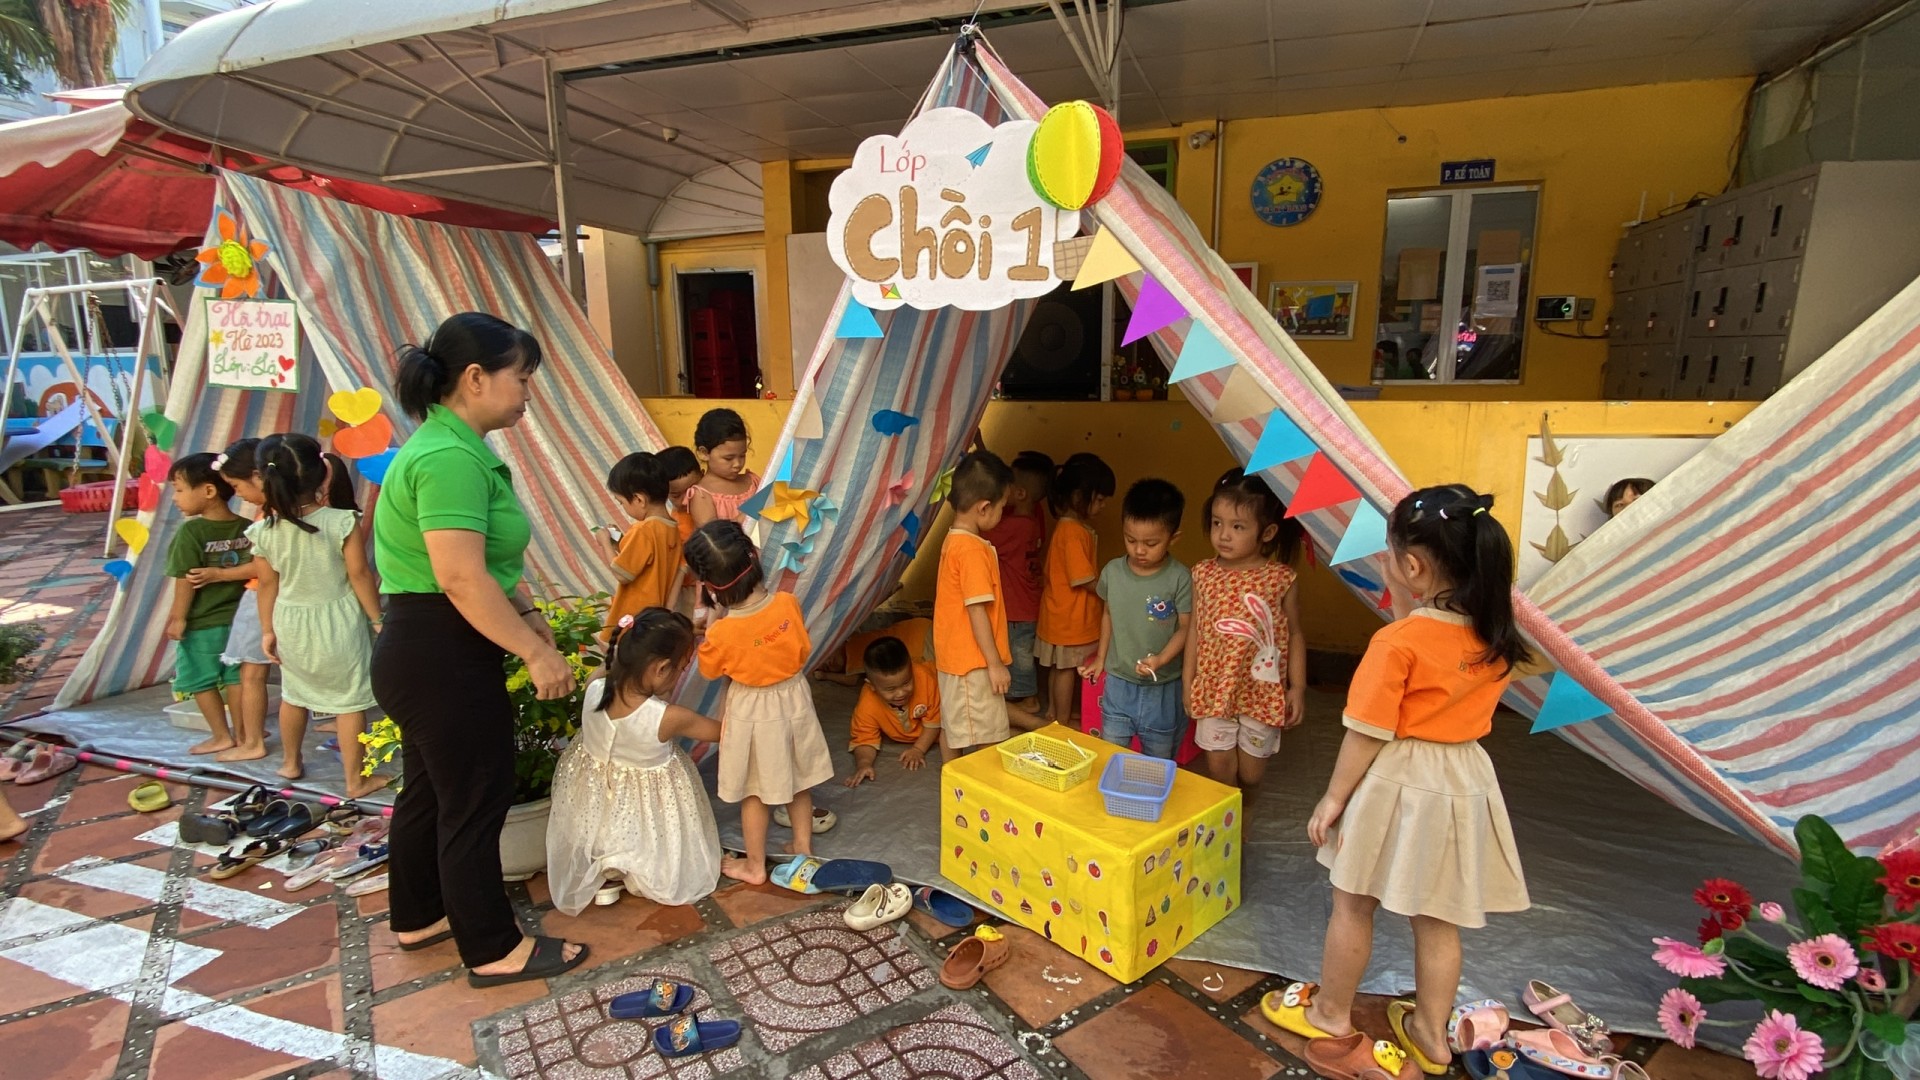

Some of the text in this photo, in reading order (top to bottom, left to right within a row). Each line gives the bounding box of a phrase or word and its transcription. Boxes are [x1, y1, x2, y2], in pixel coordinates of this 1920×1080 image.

[880, 140, 927, 182] Lớp
[844, 185, 1050, 283] Chồi 1
[255, 332, 284, 349] 2023
